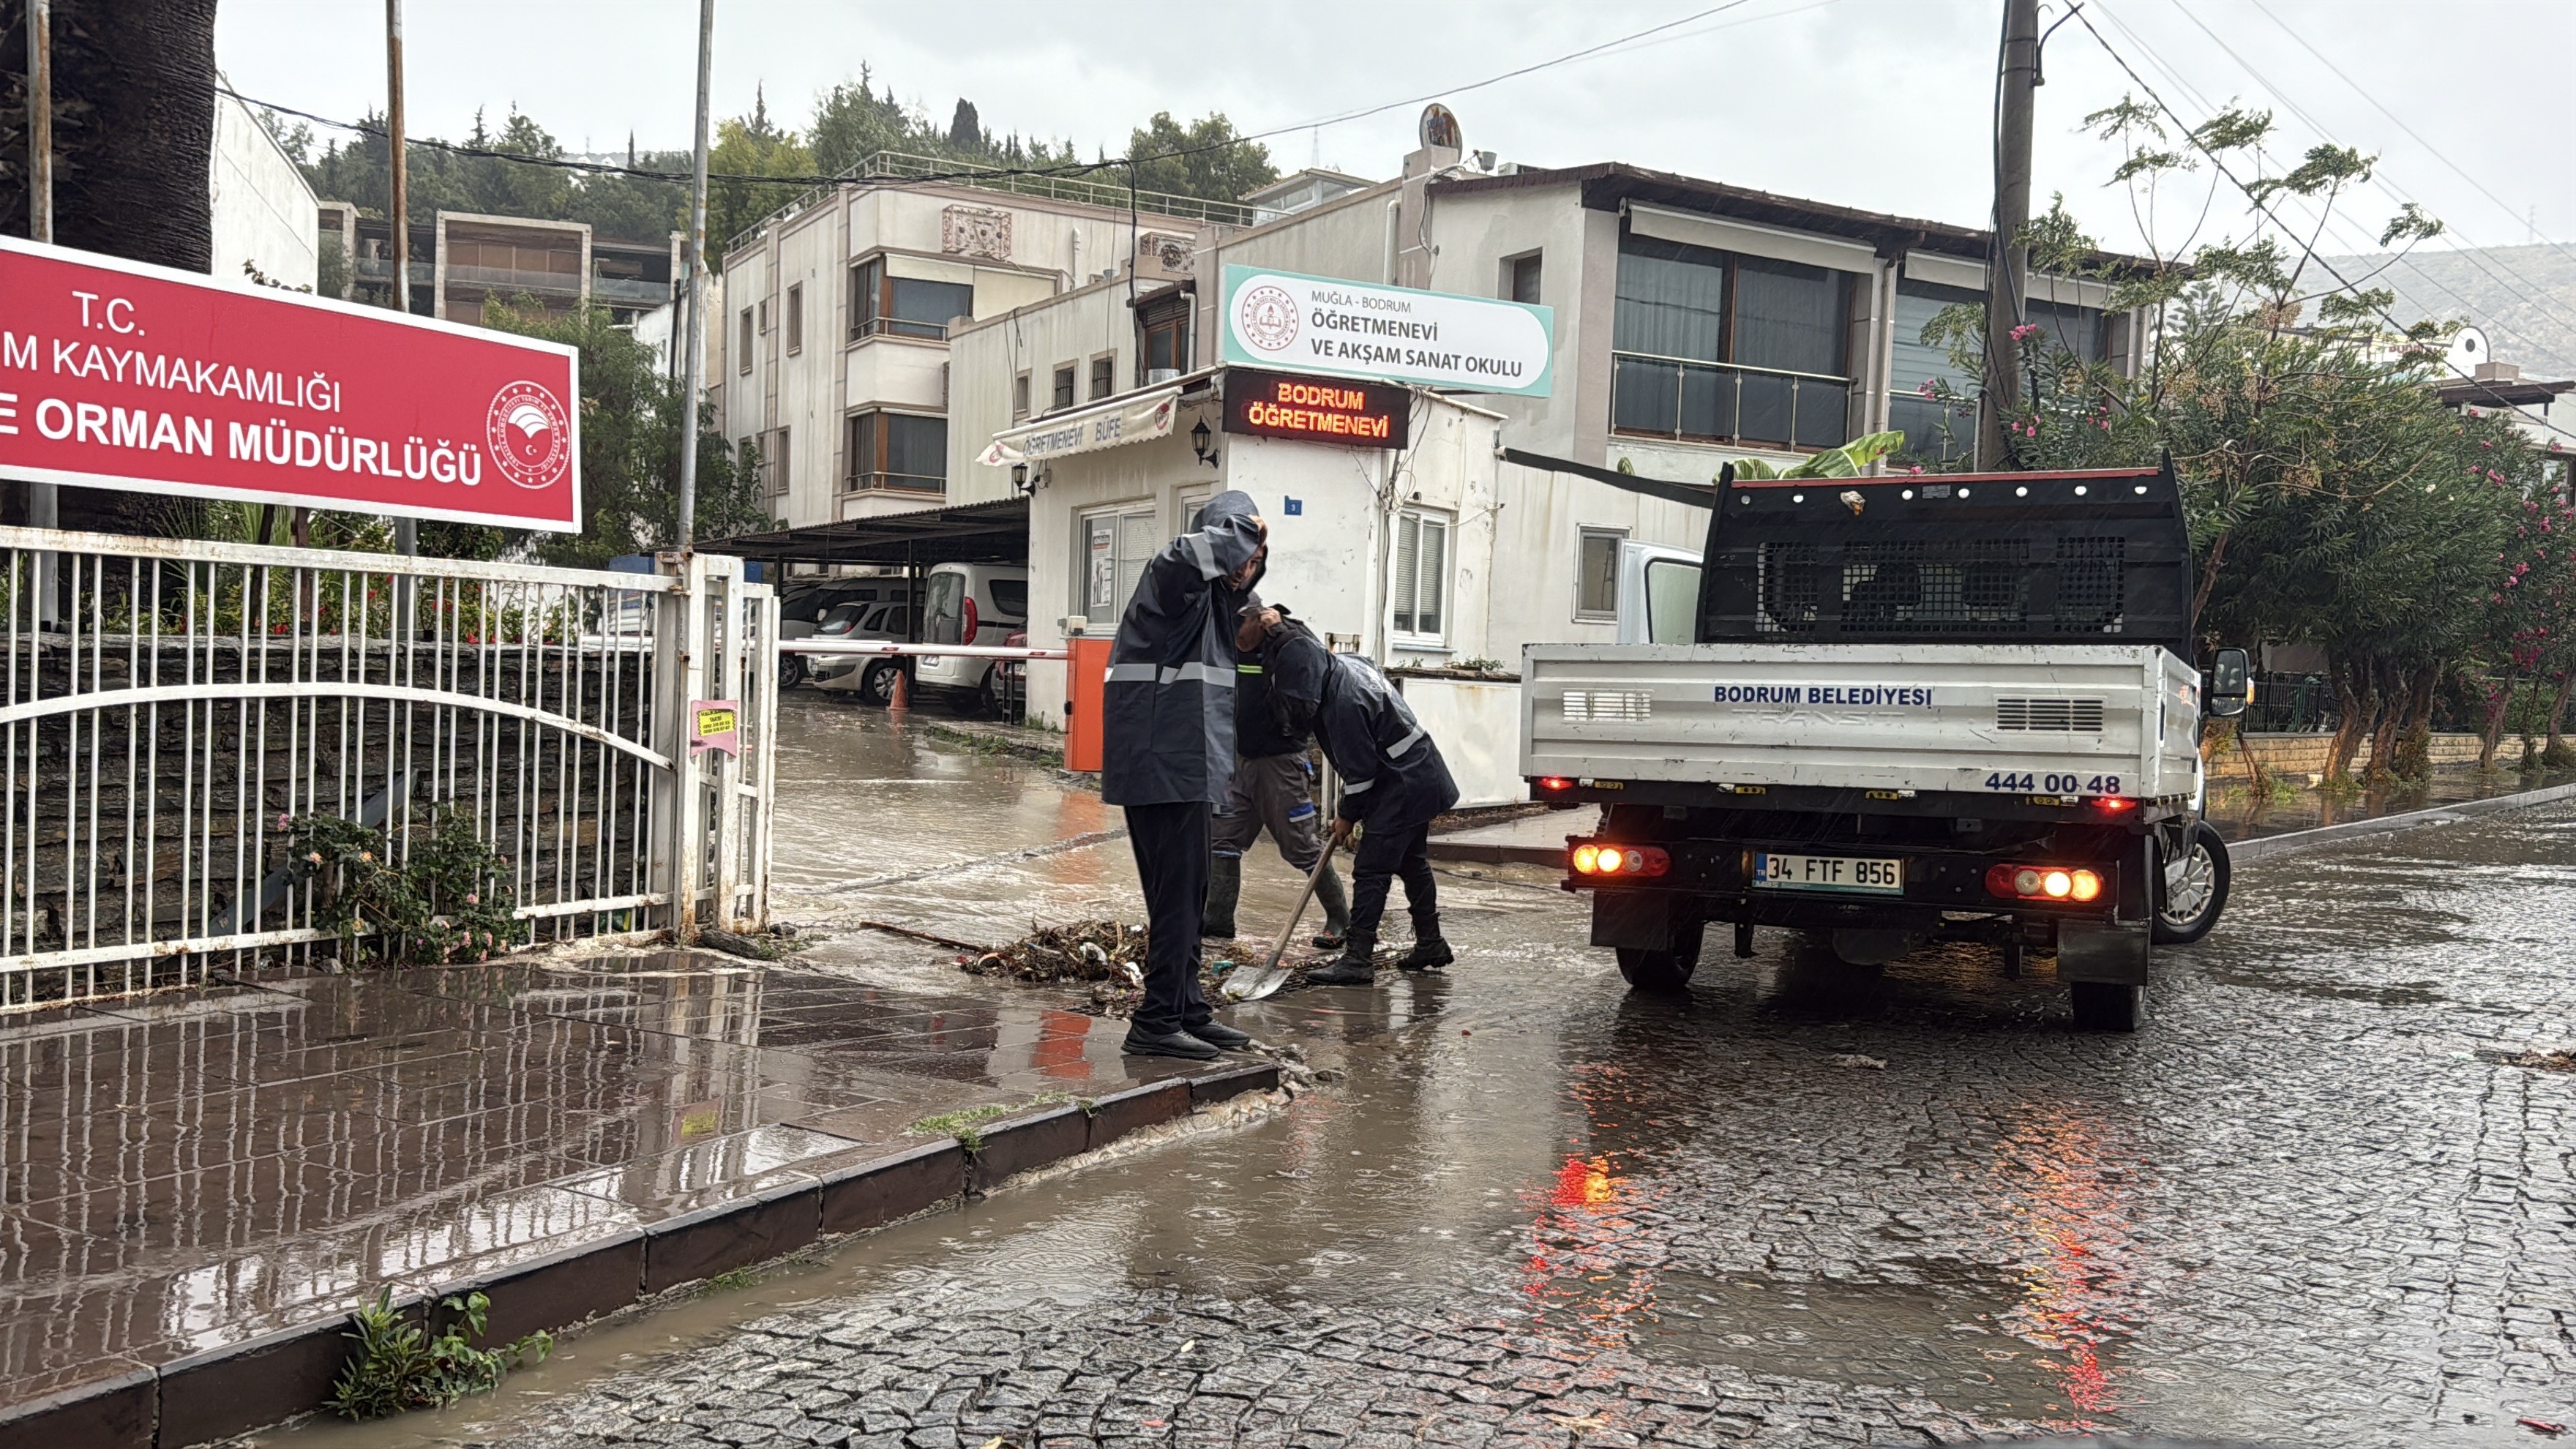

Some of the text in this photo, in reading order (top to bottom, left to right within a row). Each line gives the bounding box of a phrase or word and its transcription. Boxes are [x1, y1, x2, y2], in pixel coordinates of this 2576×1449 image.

[72, 291, 146, 336] T.C.
[1311, 291, 1352, 306] MUĞLA
[1362, 296, 1411, 313] BODRUM
[1311, 307, 1438, 341] ÖĞRETMENEVİ
[1311, 338, 1522, 377] VE AKŞAM SANAT OKULU
[53, 338, 340, 413] KAYMAKAMLIĞI
[1278, 383, 1366, 411] BODRUM
[1096, 415, 1121, 442] BÜFE
[1248, 400, 1390, 438] ÖĞRETMENEVİ
[36, 397, 212, 457] ORMAN
[229, 418, 481, 486] MÜDÜRLÜĞÜ
[1714, 686, 1801, 704] BODRUM
[1985, 772, 2121, 795] 444 00 48
[1756, 869, 1766, 877] TR
[1768, 857, 1895, 885] 34 FTF 856
